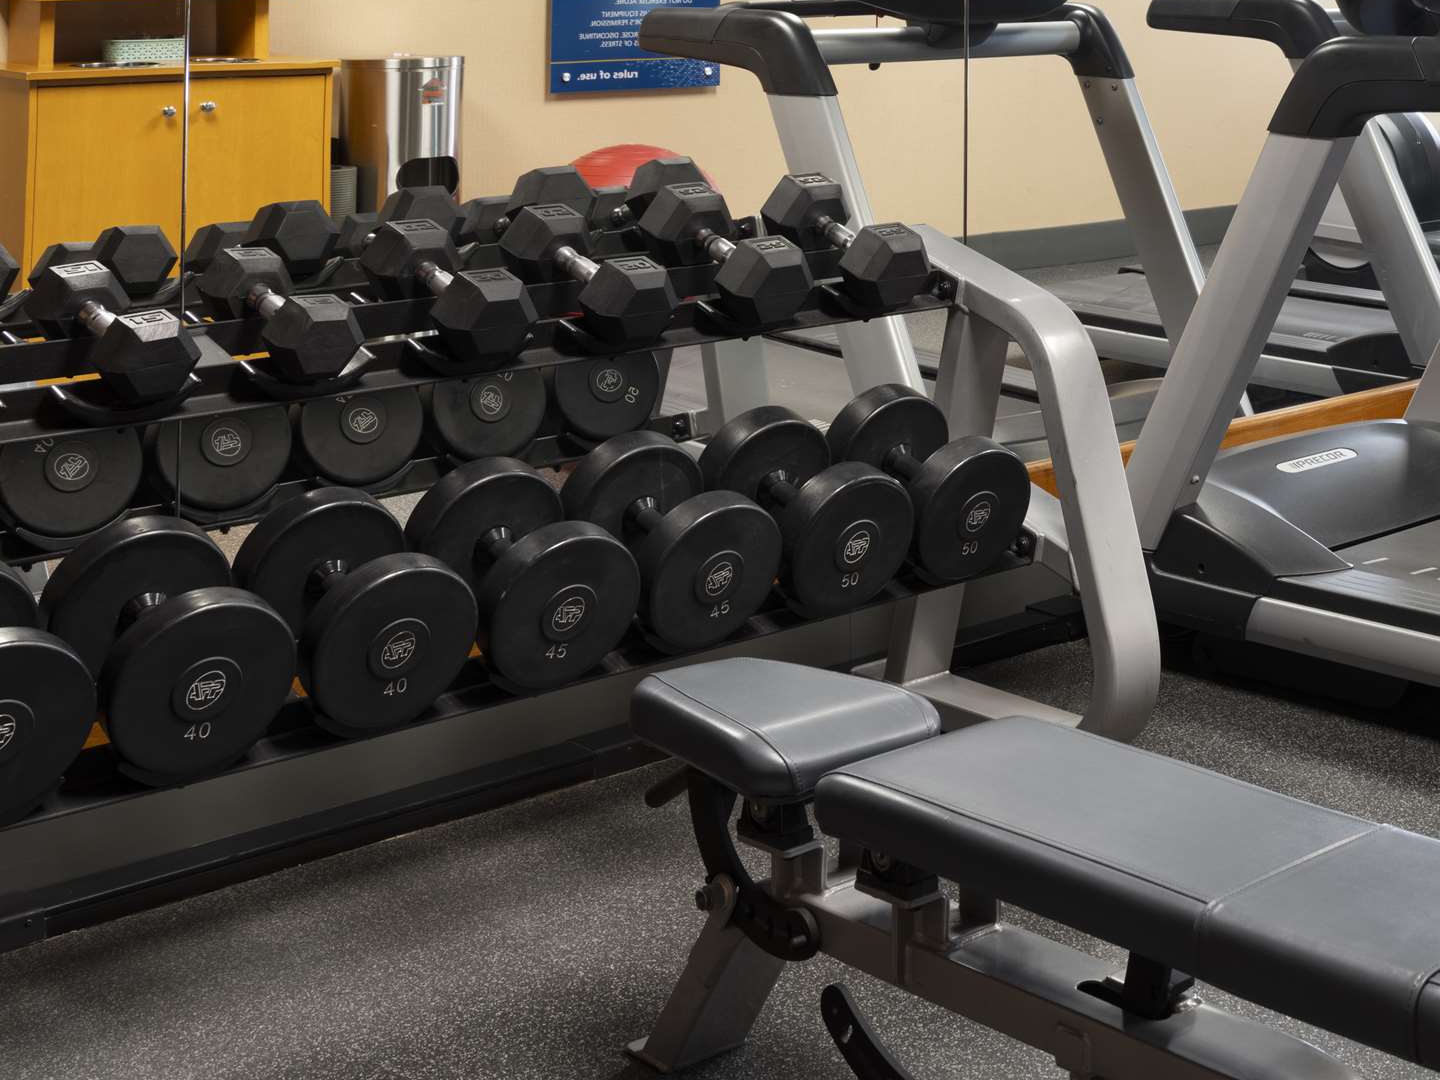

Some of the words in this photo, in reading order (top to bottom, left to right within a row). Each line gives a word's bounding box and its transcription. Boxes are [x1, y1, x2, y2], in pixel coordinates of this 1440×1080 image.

[1296, 450, 1347, 470] PRECOR
[962, 540, 978, 555] 50
[841, 572, 859, 588] 50
[710, 600, 730, 618] 45
[545, 643, 568, 659] 45
[383, 677, 407, 696] 40
[184, 721, 211, 740] 40
